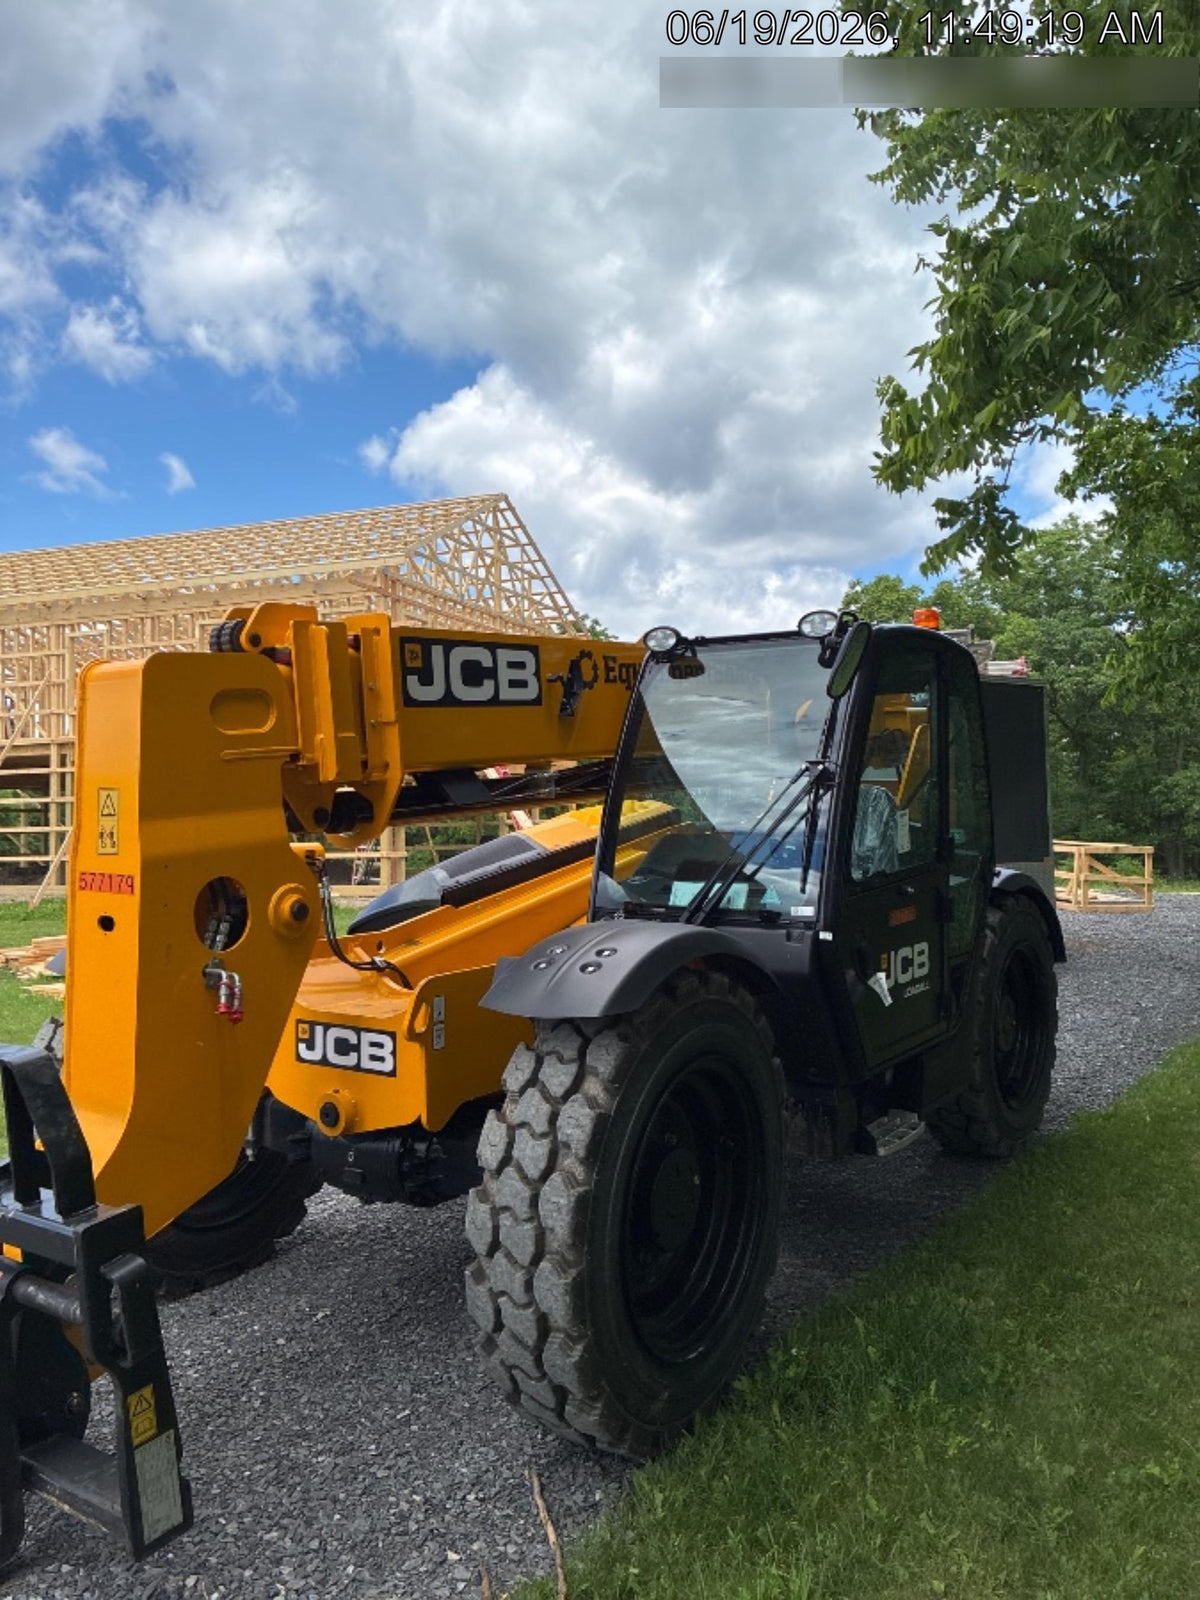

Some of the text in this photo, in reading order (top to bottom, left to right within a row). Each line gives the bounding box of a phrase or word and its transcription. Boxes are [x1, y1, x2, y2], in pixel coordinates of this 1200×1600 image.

[406, 644, 540, 701] JCB
[79, 872, 135, 896] 577179
[884, 941, 930, 989] JCB
[298, 1024, 395, 1073] JCB
